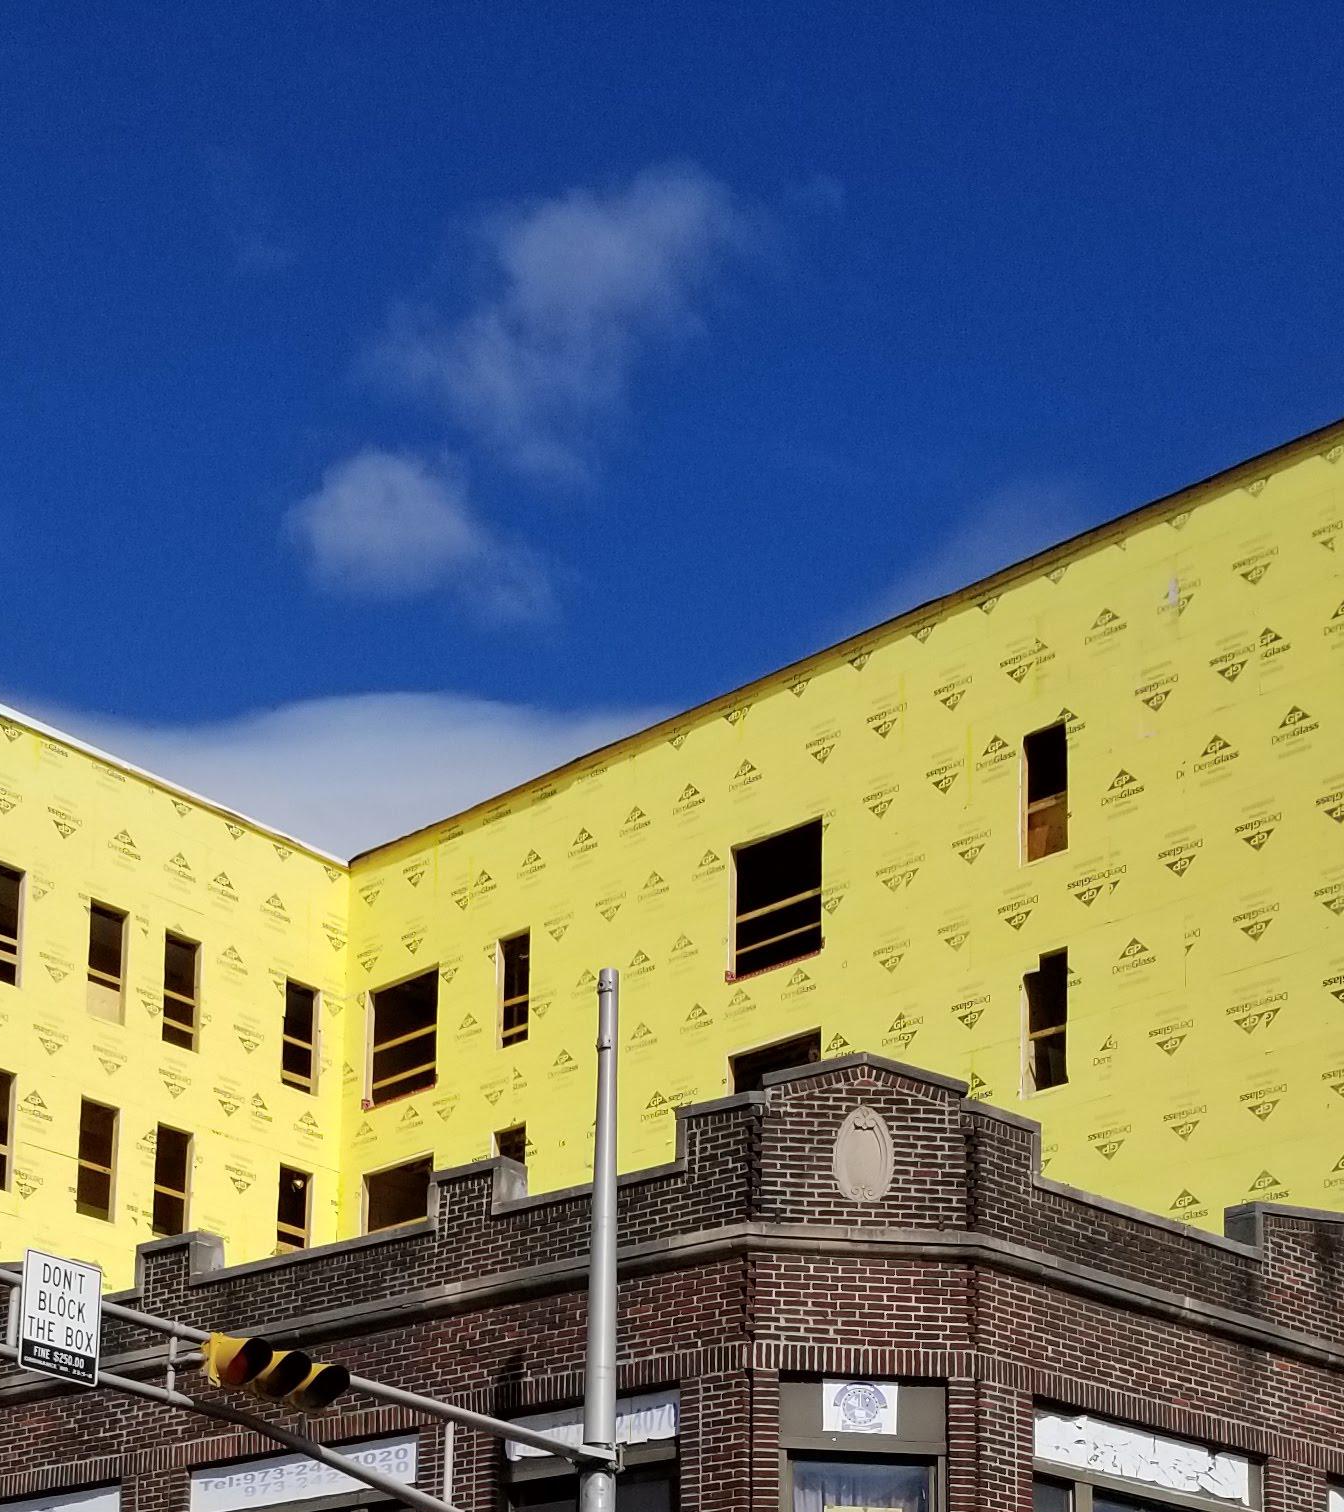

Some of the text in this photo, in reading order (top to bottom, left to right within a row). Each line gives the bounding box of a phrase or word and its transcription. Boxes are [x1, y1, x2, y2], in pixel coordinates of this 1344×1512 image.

[42, 1263, 85, 1294] DON'T
[38, 1290, 85, 1323] BLOCK
[28, 1315, 94, 1353] THE BOX
[33, 1346, 51, 1360] FINE
[53, 1351, 85, 1369] $250.00
